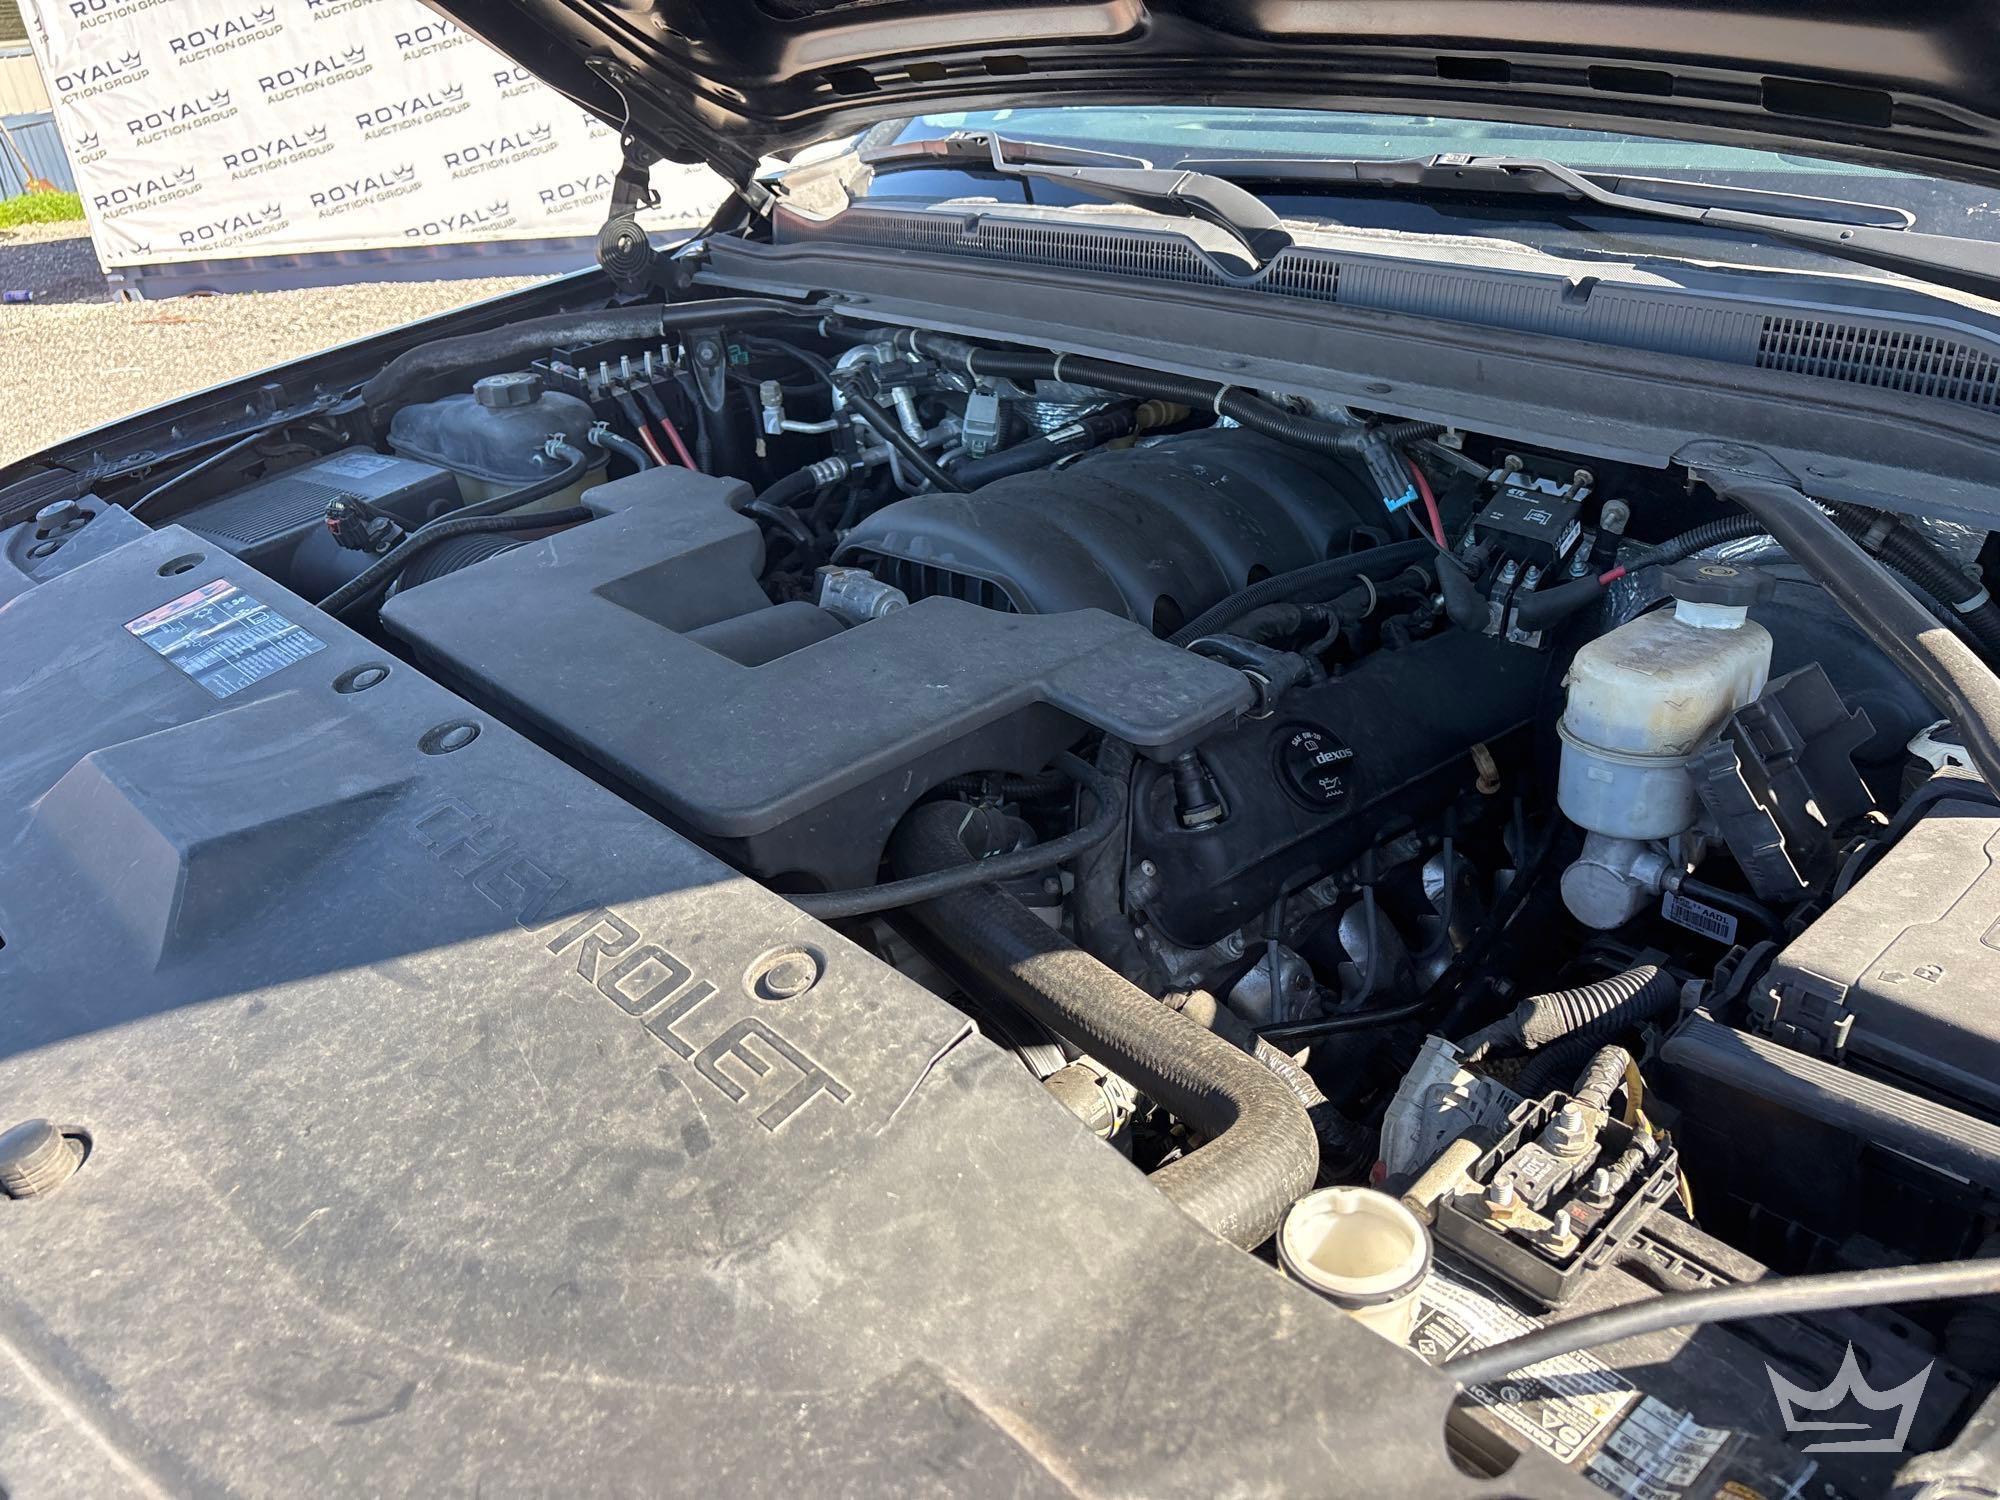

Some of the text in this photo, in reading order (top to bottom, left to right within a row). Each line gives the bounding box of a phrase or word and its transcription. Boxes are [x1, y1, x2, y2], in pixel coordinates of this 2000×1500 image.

[80, 4, 137, 31] AUCTION
[169, 16, 255, 54] ROYAL
[395, 20, 457, 49] ROY
[180, 24, 283, 66] AUCTION GROUP
[403, 35, 463, 61] AUCTION
[55, 61, 122, 91] OYAL
[104, 69, 149, 90] GROUP
[259, 56, 345, 92] ROYAL
[268, 64, 373, 104] AUCTION GROUP
[127, 99, 211, 135] ROYAL
[136, 107, 238, 147] AUCTION GROUP
[356, 93, 443, 129] ROYAL
[365, 102, 471, 141] AUCTION GROUP
[223, 134, 308, 169] ROYAL
[231, 143, 335, 181] AUCTION GROUP
[444, 132, 531, 168] ROYAL
[452, 141, 559, 180] AUCTION GROUP
[94, 175, 176, 210] ROYAL
[102, 183, 202, 221] AUCTION GROUP
[310, 173, 394, 207] ROYAL
[179, 212, 262, 246] ROYAL
[1316, 748, 1353, 764] dexos
[414, 796, 853, 1132] CHEVROLET
[1494, 1401, 1554, 1446] DANGER
